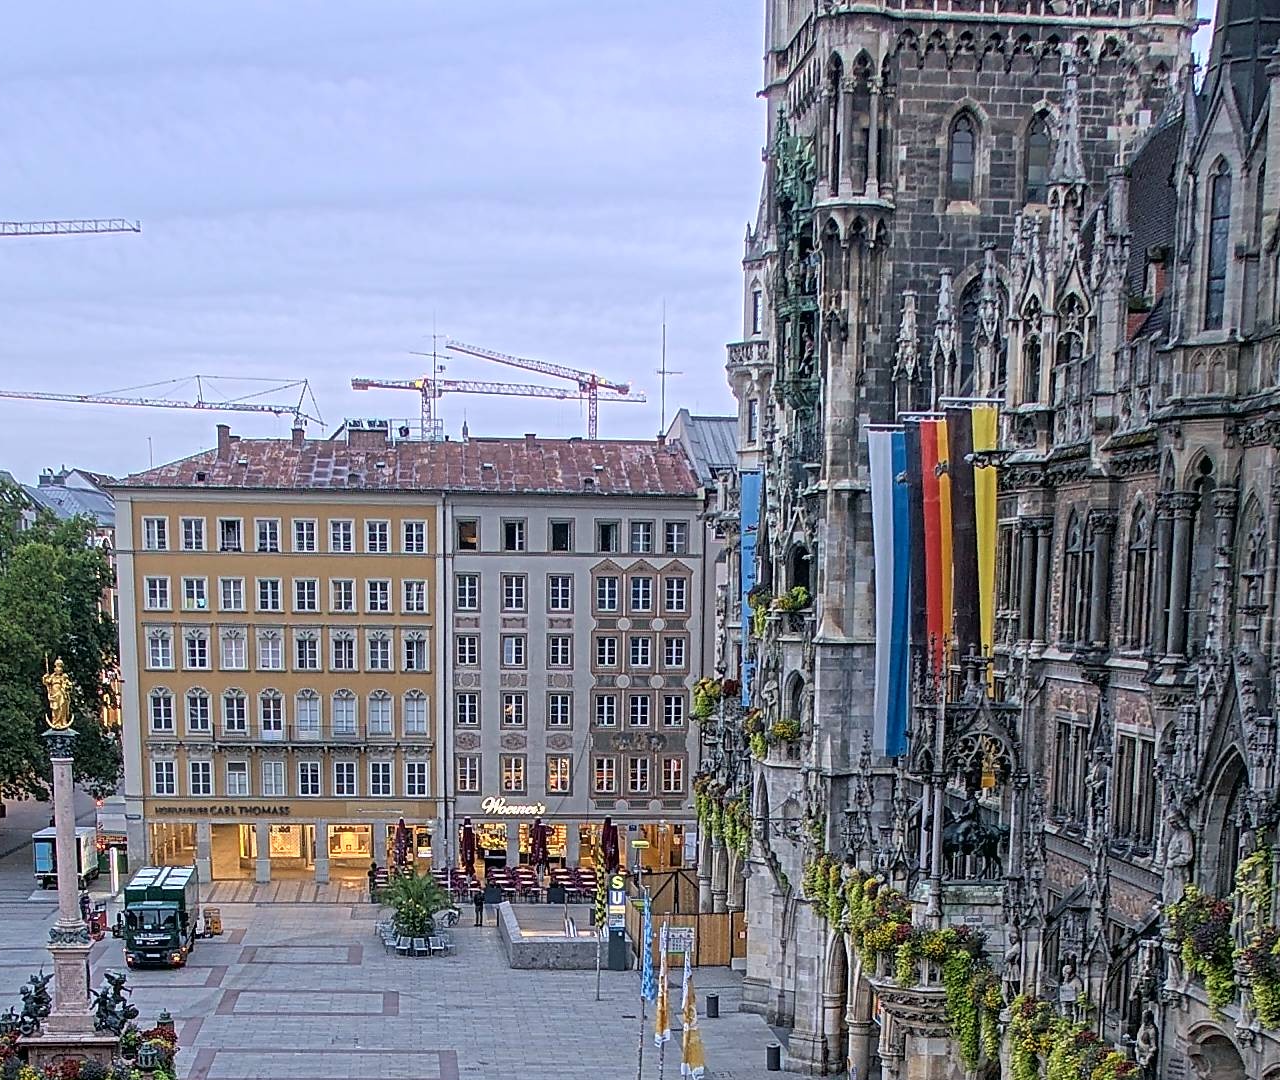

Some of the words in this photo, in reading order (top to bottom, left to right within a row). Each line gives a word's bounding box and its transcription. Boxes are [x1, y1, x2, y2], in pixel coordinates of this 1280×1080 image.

[210, 806, 236, 815] CARL
[612, 875, 624, 889] S
[612, 891, 623, 904] U
